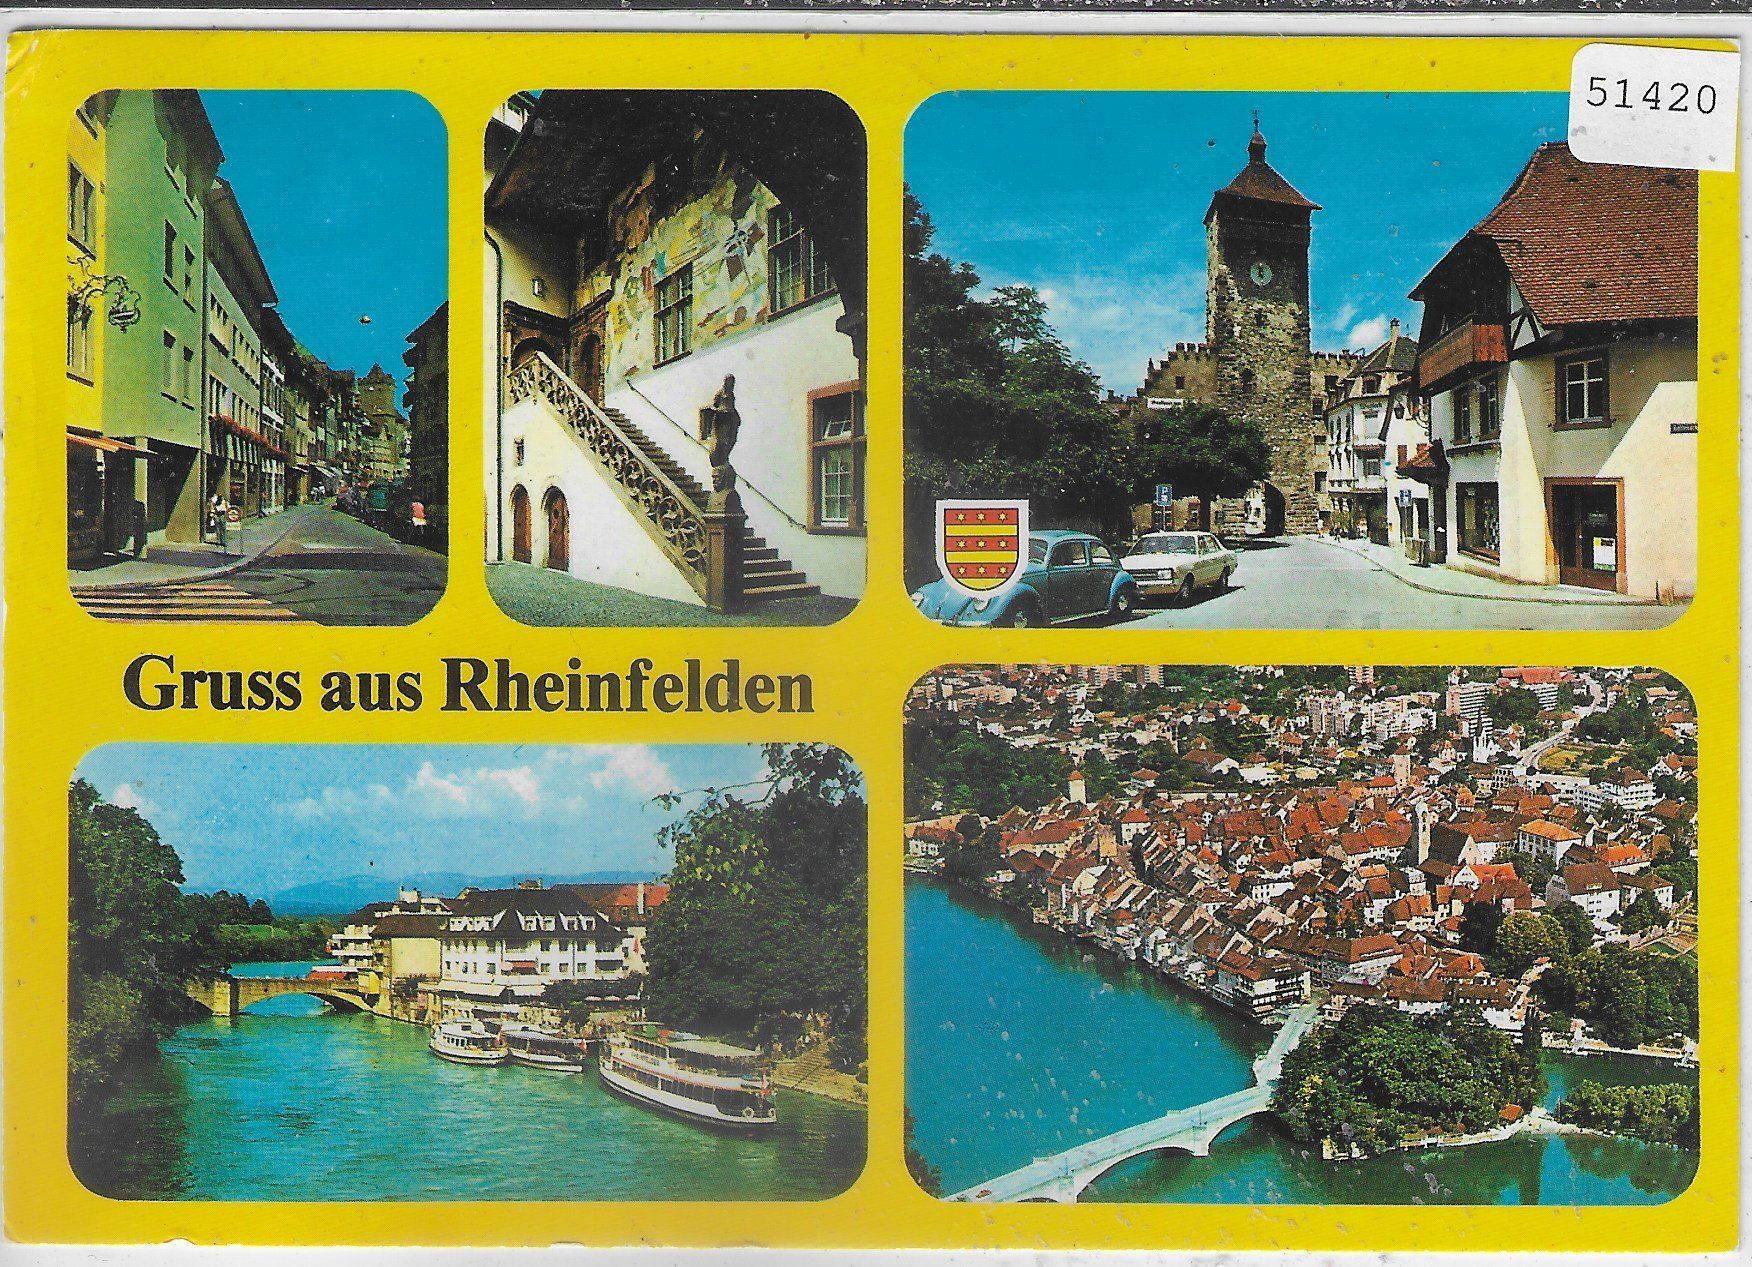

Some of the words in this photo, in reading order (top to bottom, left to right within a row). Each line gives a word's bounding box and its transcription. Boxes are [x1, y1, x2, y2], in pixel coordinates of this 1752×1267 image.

[1586, 76, 1717, 114] 51420
[123, 652, 302, 711] Gruss
[320, 671, 423, 712] aus
[440, 657, 815, 714] Rheinfelden
